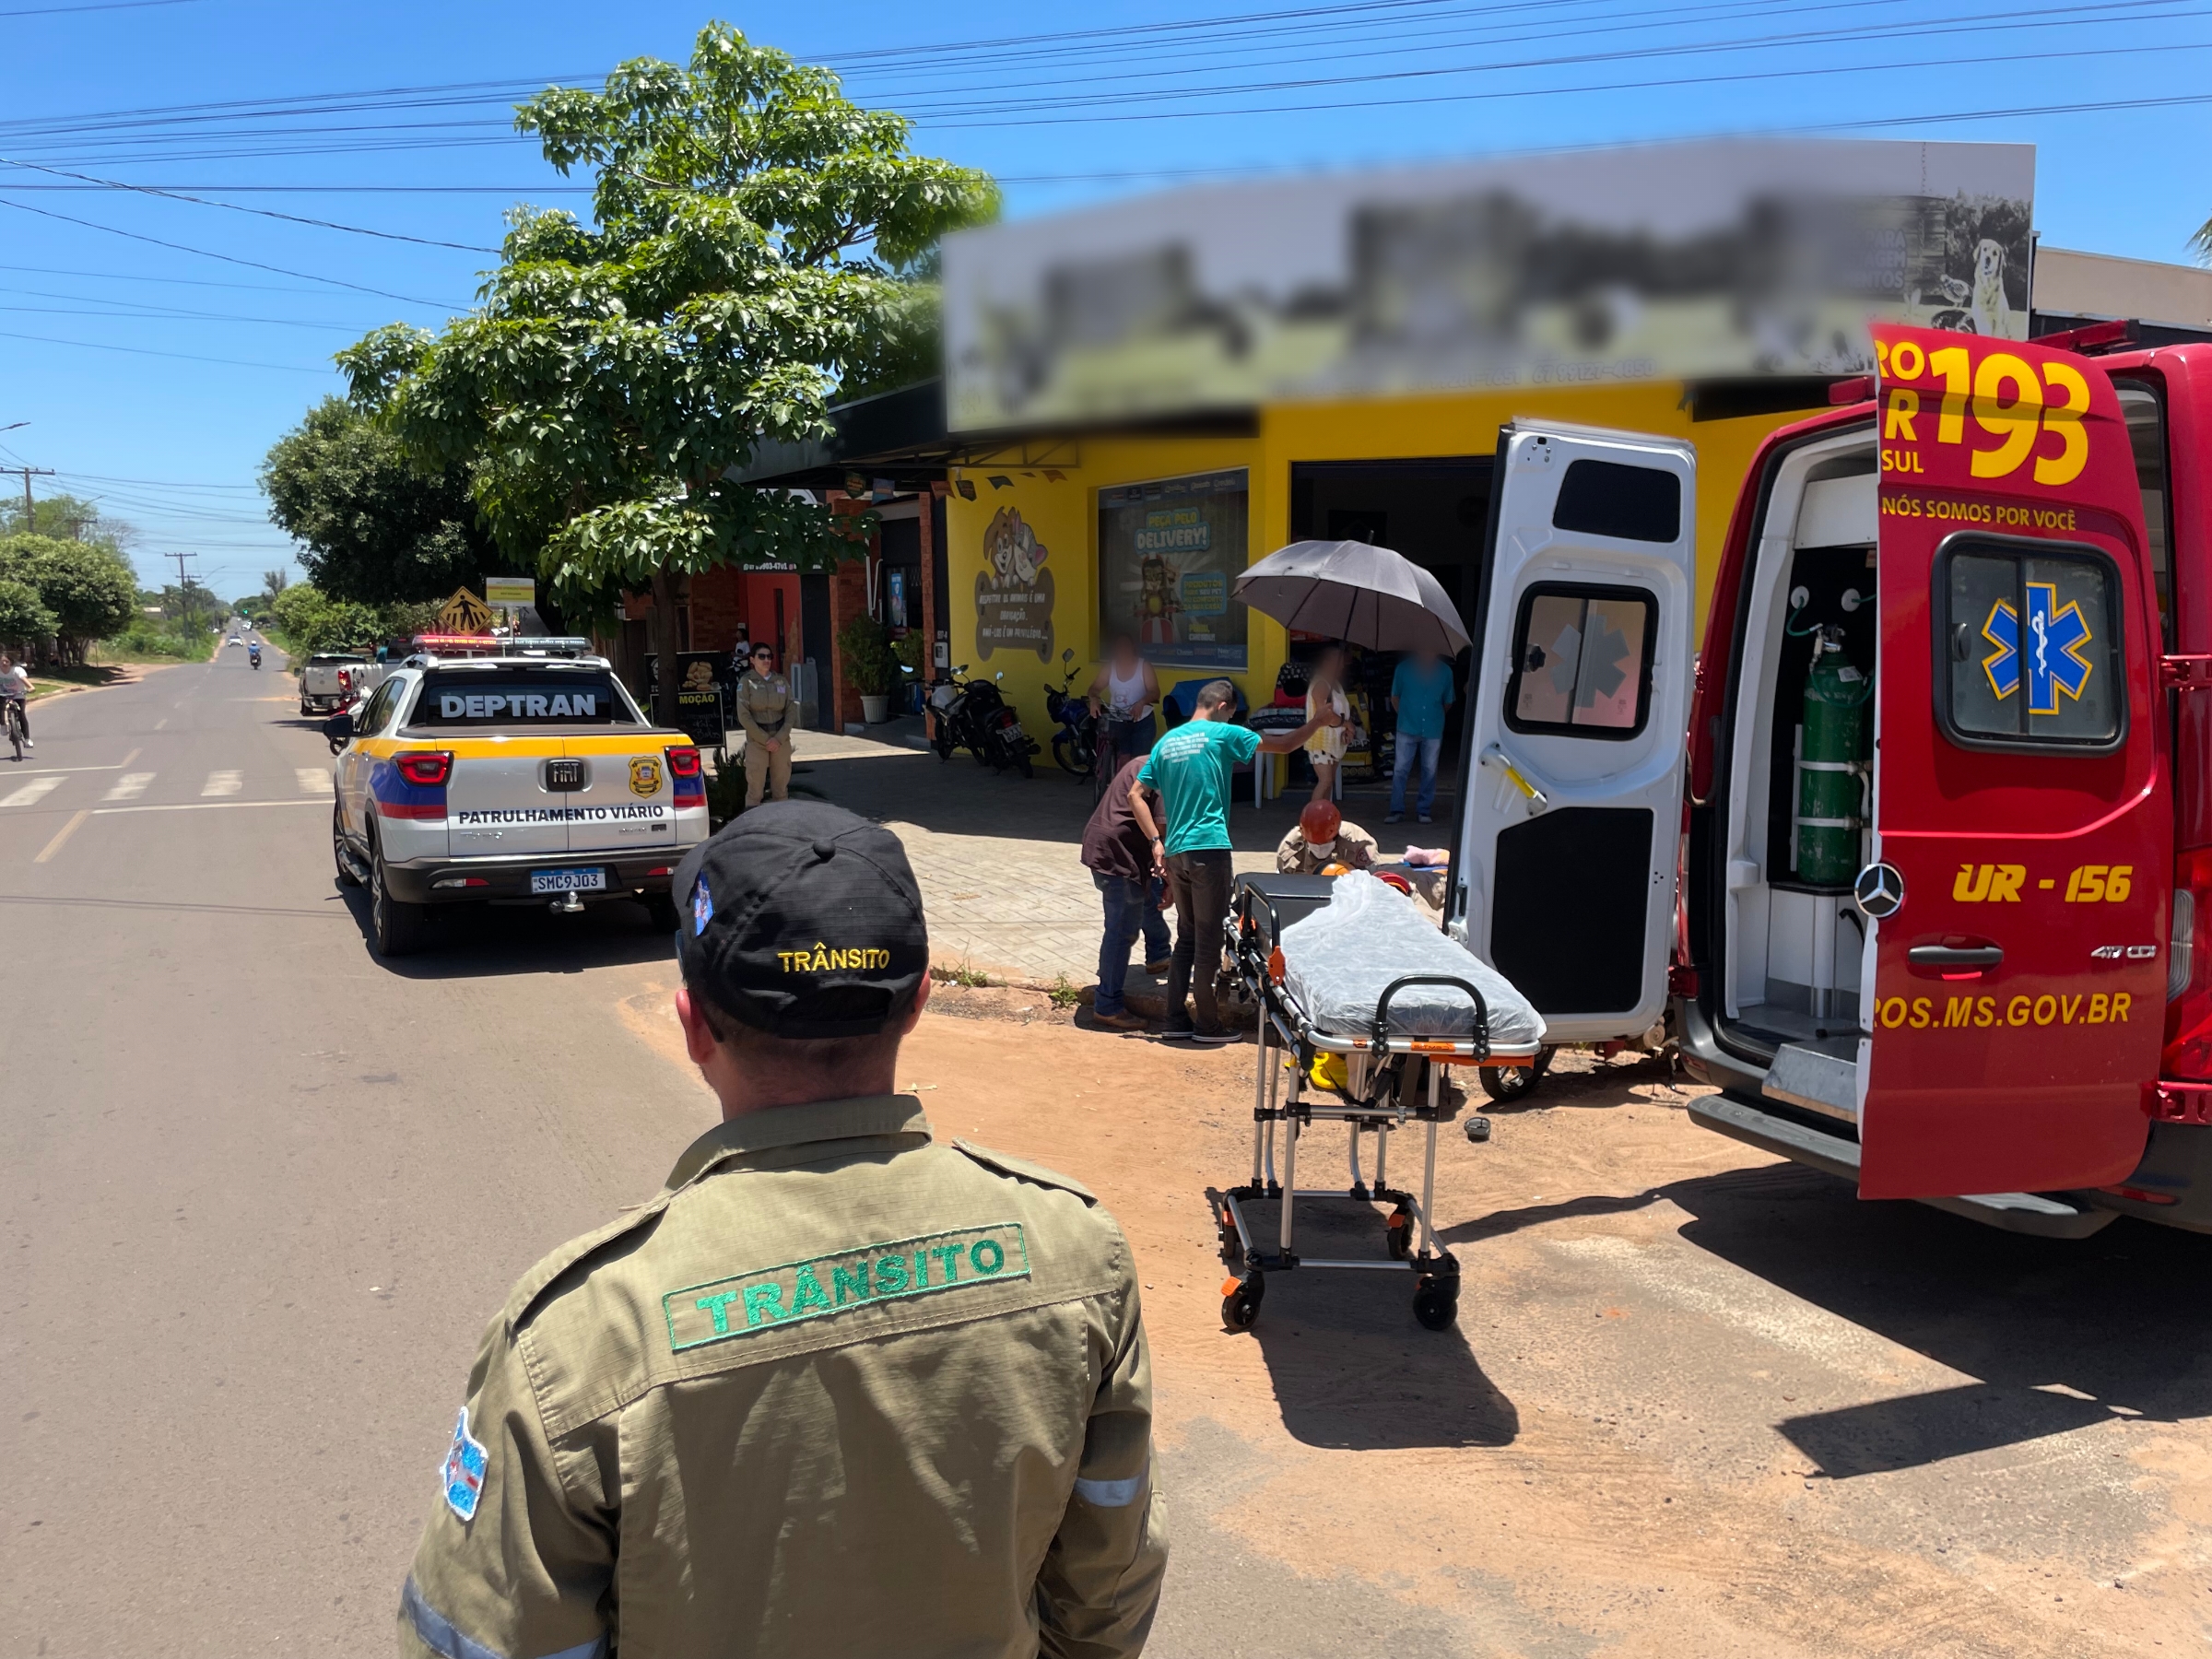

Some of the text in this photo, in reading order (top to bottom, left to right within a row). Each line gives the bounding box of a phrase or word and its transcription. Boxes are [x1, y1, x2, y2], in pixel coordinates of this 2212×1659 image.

[1929, 347, 2090, 486] 193
[1881, 449, 1924, 474] SUL
[1148, 511, 1197, 528] PEÇA PELO
[1882, 494, 2077, 531] NÓS SOMOS POR VOCÊ
[1137, 525, 1207, 549] DELIVERY!
[441, 694, 595, 718] DEPTRAN
[459, 803, 664, 824] PATRULHAMENTO VIÁRIO
[538, 874, 598, 890] SMC9J03
[1952, 864, 2133, 902] UR - 156
[778, 942, 890, 973] TRÂNSITO
[696, 1240, 1005, 1334] TRÂNSITO
